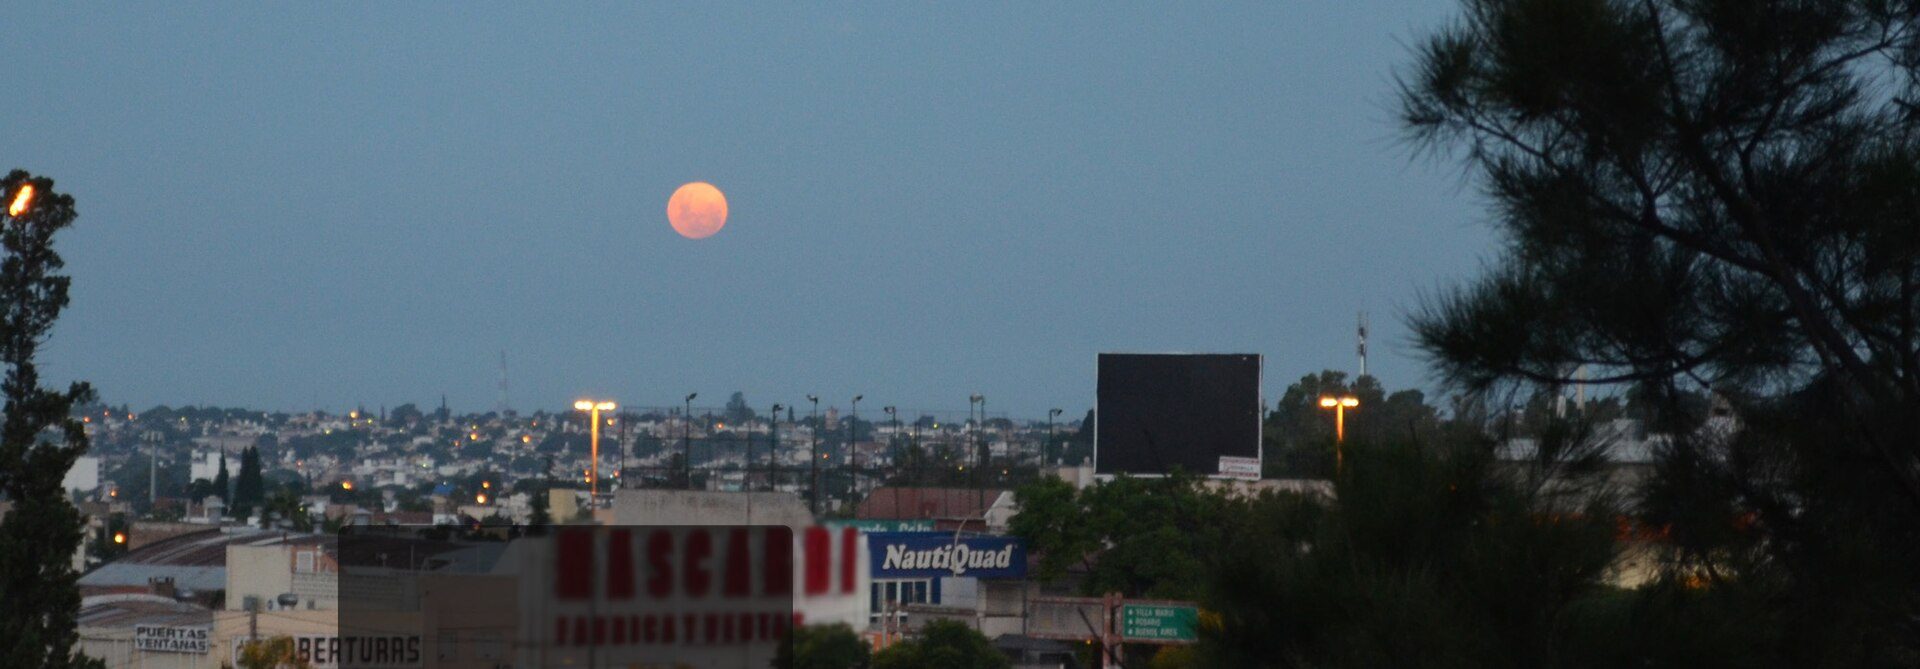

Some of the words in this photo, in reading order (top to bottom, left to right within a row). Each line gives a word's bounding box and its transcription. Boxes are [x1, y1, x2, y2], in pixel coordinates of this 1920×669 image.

[882, 544, 1011, 574] NautiQuad
[136, 626, 207, 640] PUERTAS
[136, 638, 207, 651] VENTANAS
